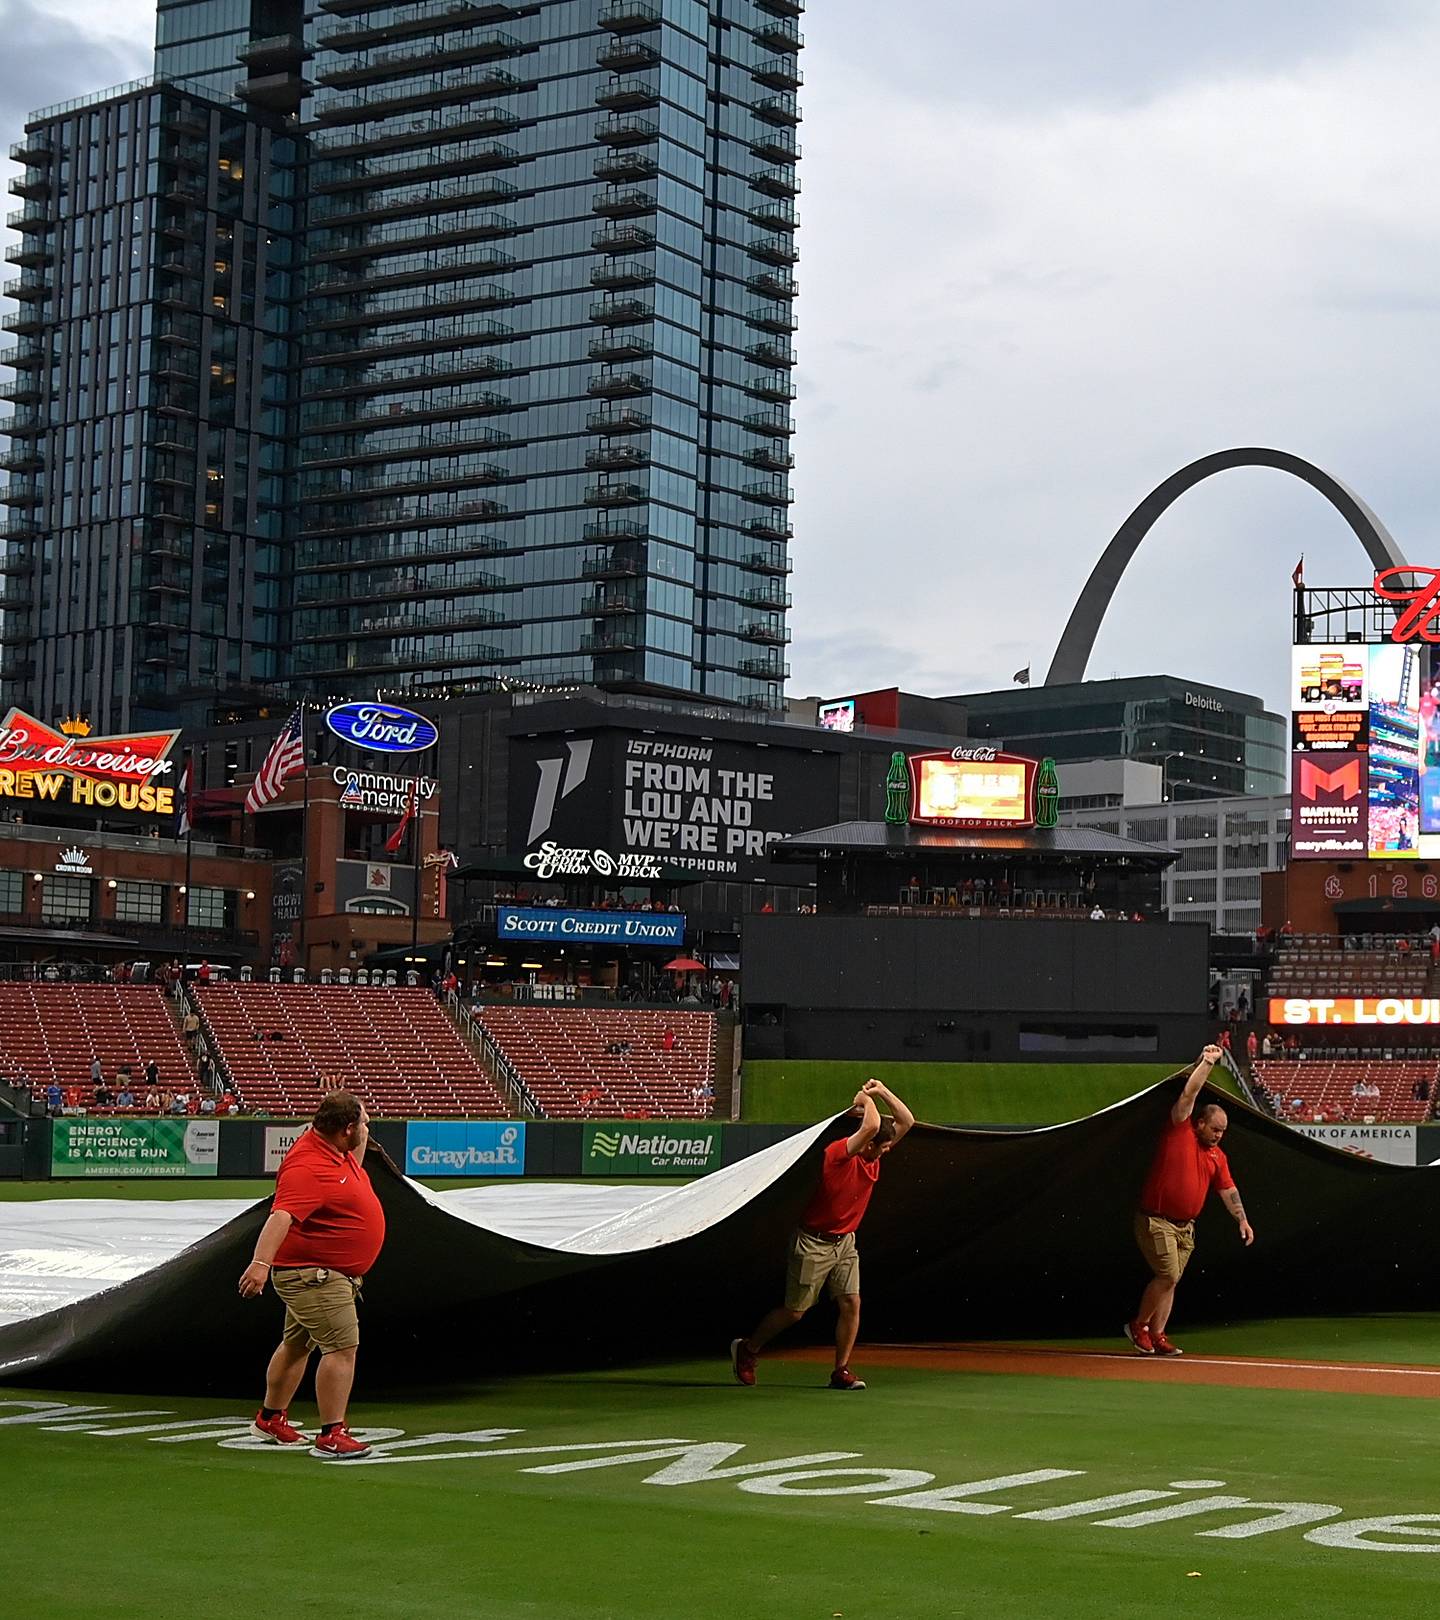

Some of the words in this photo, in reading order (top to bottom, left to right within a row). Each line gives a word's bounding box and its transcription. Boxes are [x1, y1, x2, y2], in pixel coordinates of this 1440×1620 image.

[351, 707, 418, 745] Ford
[0, 728, 173, 776] Budweiser
[333, 766, 436, 799] Community
[625, 760, 710, 794] FROM
[718, 770, 773, 800] THE
[72, 777, 174, 814] HOUSE
[624, 789, 682, 820] LOU
[689, 796, 752, 827] AND
[1300, 806, 1359, 818] MARYVILLE
[932, 818, 981, 826] ROOFTOP
[623, 819, 718, 852] WE'RE
[1295, 839, 1364, 852] maryville.edu
[617, 853, 655, 866] MVP
[617, 865, 662, 878] DECK
[1368, 874, 1377, 898] 1
[1392, 874, 1408, 898] 2
[1421, 874, 1438, 898] 6
[1283, 998, 1341, 1024] ST.
[69, 1126, 123, 1136] ENERGY
[1299, 1128, 1328, 1139] ANK
[1330, 1128, 1348, 1139] OF
[1350, 1128, 1412, 1139] AMERICA
[69, 1137, 147, 1147] EFFICIENCY
[619, 1135, 712, 1155] National
[68, 1148, 81, 1157] IS
[85, 1148, 94, 1157] A
[98, 1148, 136, 1158] HOME
[141, 1148, 168, 1157] RUN
[651, 1157, 670, 1165] Car
[673, 1157, 708, 1165] Rental
[85, 1166, 186, 1175] AMEREN.COM/REBATES
